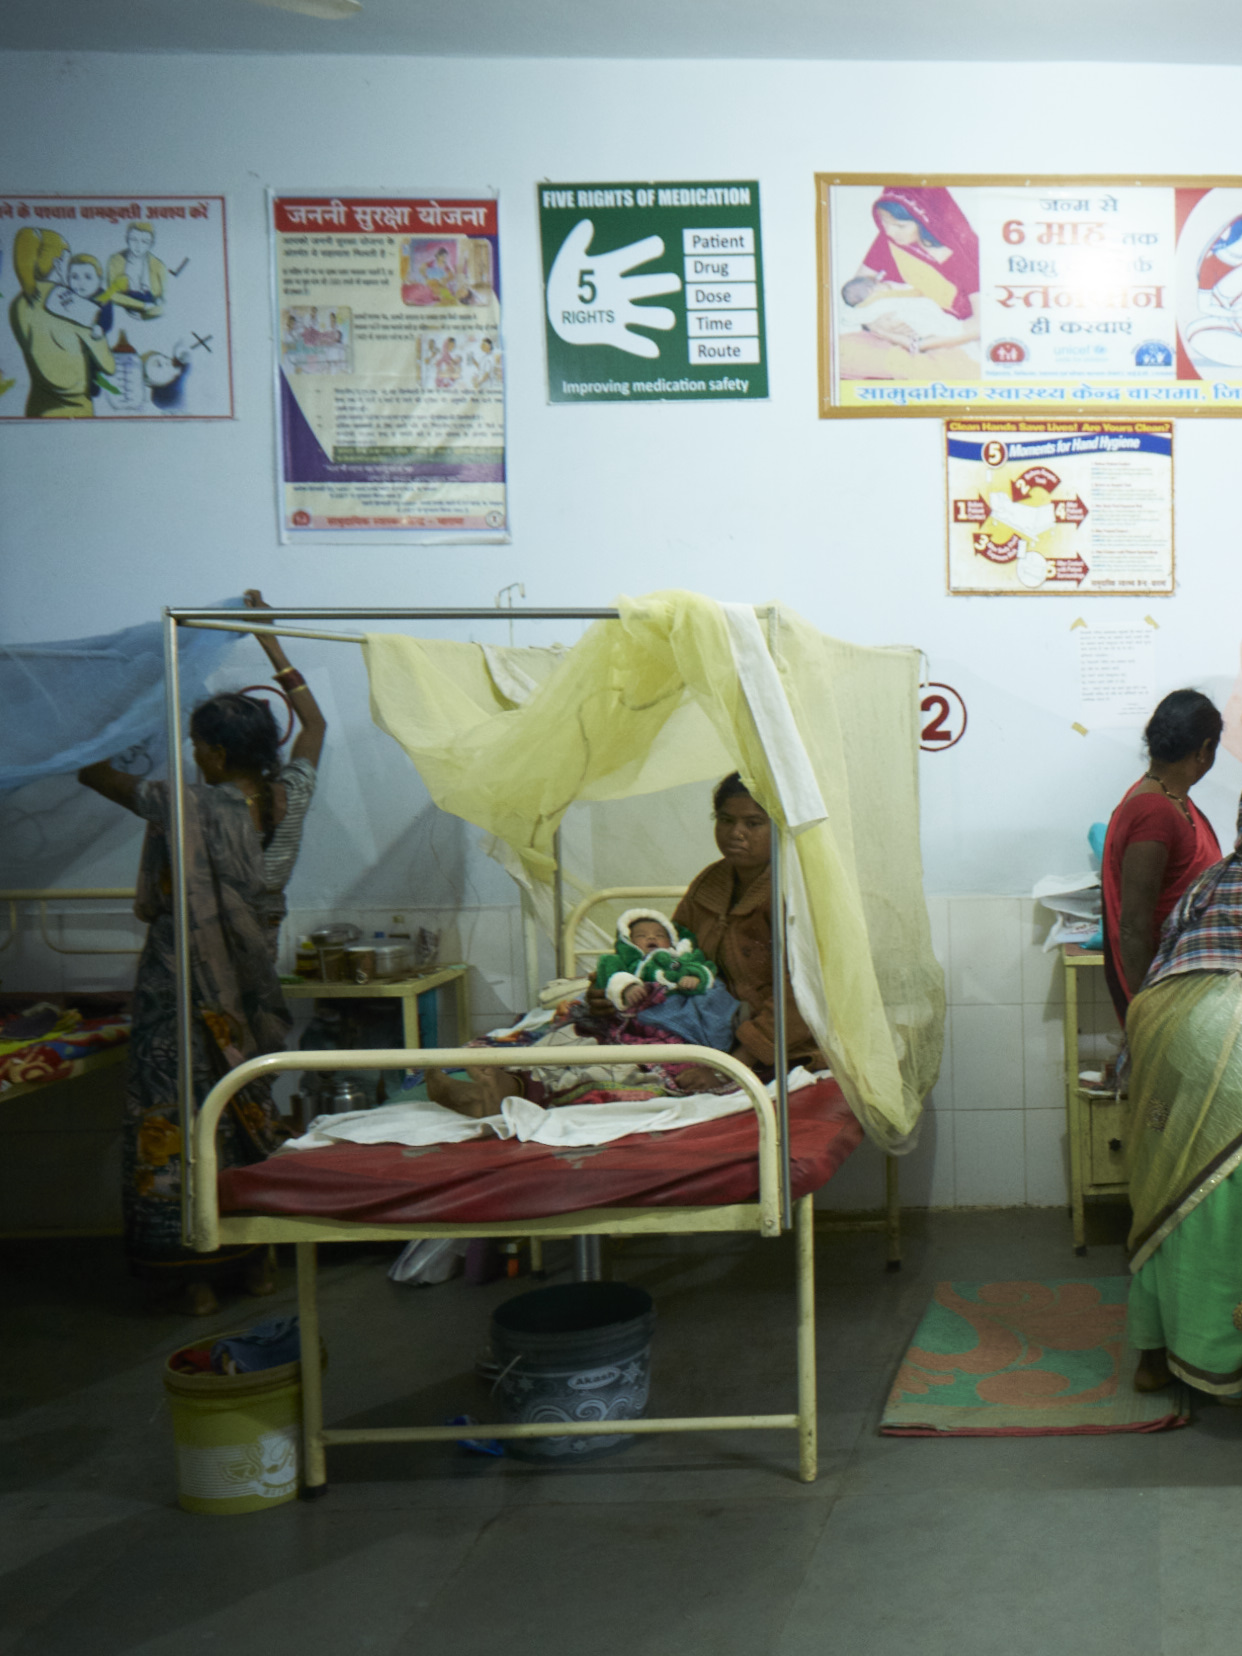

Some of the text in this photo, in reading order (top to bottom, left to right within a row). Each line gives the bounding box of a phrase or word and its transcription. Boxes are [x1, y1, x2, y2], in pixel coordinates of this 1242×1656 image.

[542, 188, 750, 208] FIVE RIGHTS OF MEDICATION
[1039, 194, 1119, 212] जन्म से
[284, 200, 487, 231] जननी सुरक्षा योजना
[692, 234, 744, 249] Patient
[1002, 219, 1159, 246] 6 माह तक
[694, 261, 728, 276] Drug
[578, 269, 597, 304] 5
[695, 289, 731, 303] Dose
[994, 284, 1166, 309] स्तनान
[562, 310, 615, 324] RIGHTS
[696, 317, 732, 330] Time
[1029, 316, 1051, 335] ही
[698, 343, 741, 357] Route
[562, 377, 749, 395] Improving medication safety
[856, 382, 978, 404] सामुदायिक
[984, 387, 1065, 400] स्वास्थ्य
[1072, 383, 1121, 400] केन्द्र
[949, 422, 1170, 433] Clean Hands Save Lives! Are Yours Clean?
[988, 436, 1141, 464] 5 Moments for Hand Hygiene
[1015, 479, 1030, 496] 2
[957, 502, 967, 520] 1
[1056, 502, 1066, 520] 4
[974, 535, 989, 550] 3
[921, 694, 951, 741] 2
